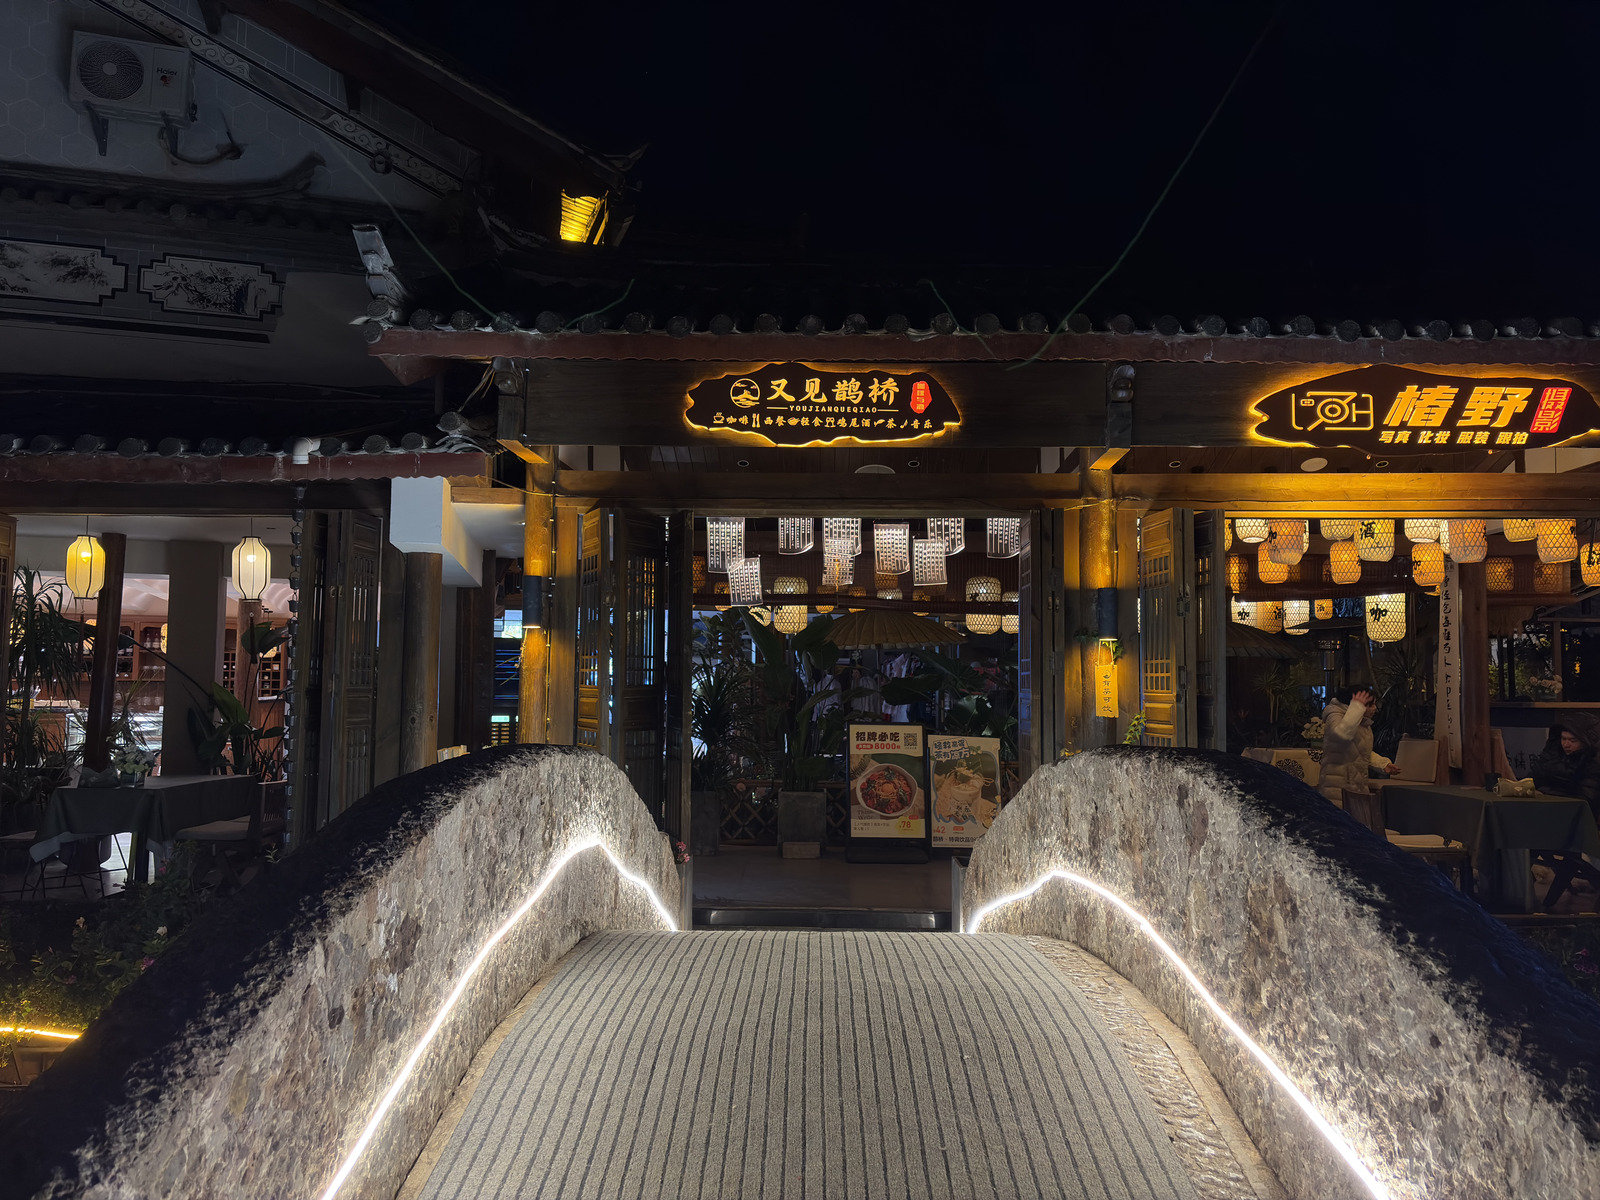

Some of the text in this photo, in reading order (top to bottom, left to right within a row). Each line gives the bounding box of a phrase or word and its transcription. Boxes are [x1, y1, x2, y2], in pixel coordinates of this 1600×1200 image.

[156, 67, 177, 76] Haier
[766, 377, 900, 406] 又见鹊桥
[789, 405, 878, 413] YOUJIANQUEQIAO
[1382, 385, 1534, 428] 椿野
[1532, 388, 1570, 432] 摄影
[726, 415, 933, 429] 咖啡 西餐 轻食 鸡尾酒 茶 音乐
[1379, 431, 1529, 445] 写真 化妆 服装 跟拍
[1237, 607, 1250, 620] 咖
[1370, 604, 1388, 622] 咖
[855, 731, 900, 742] 招牌必吃
